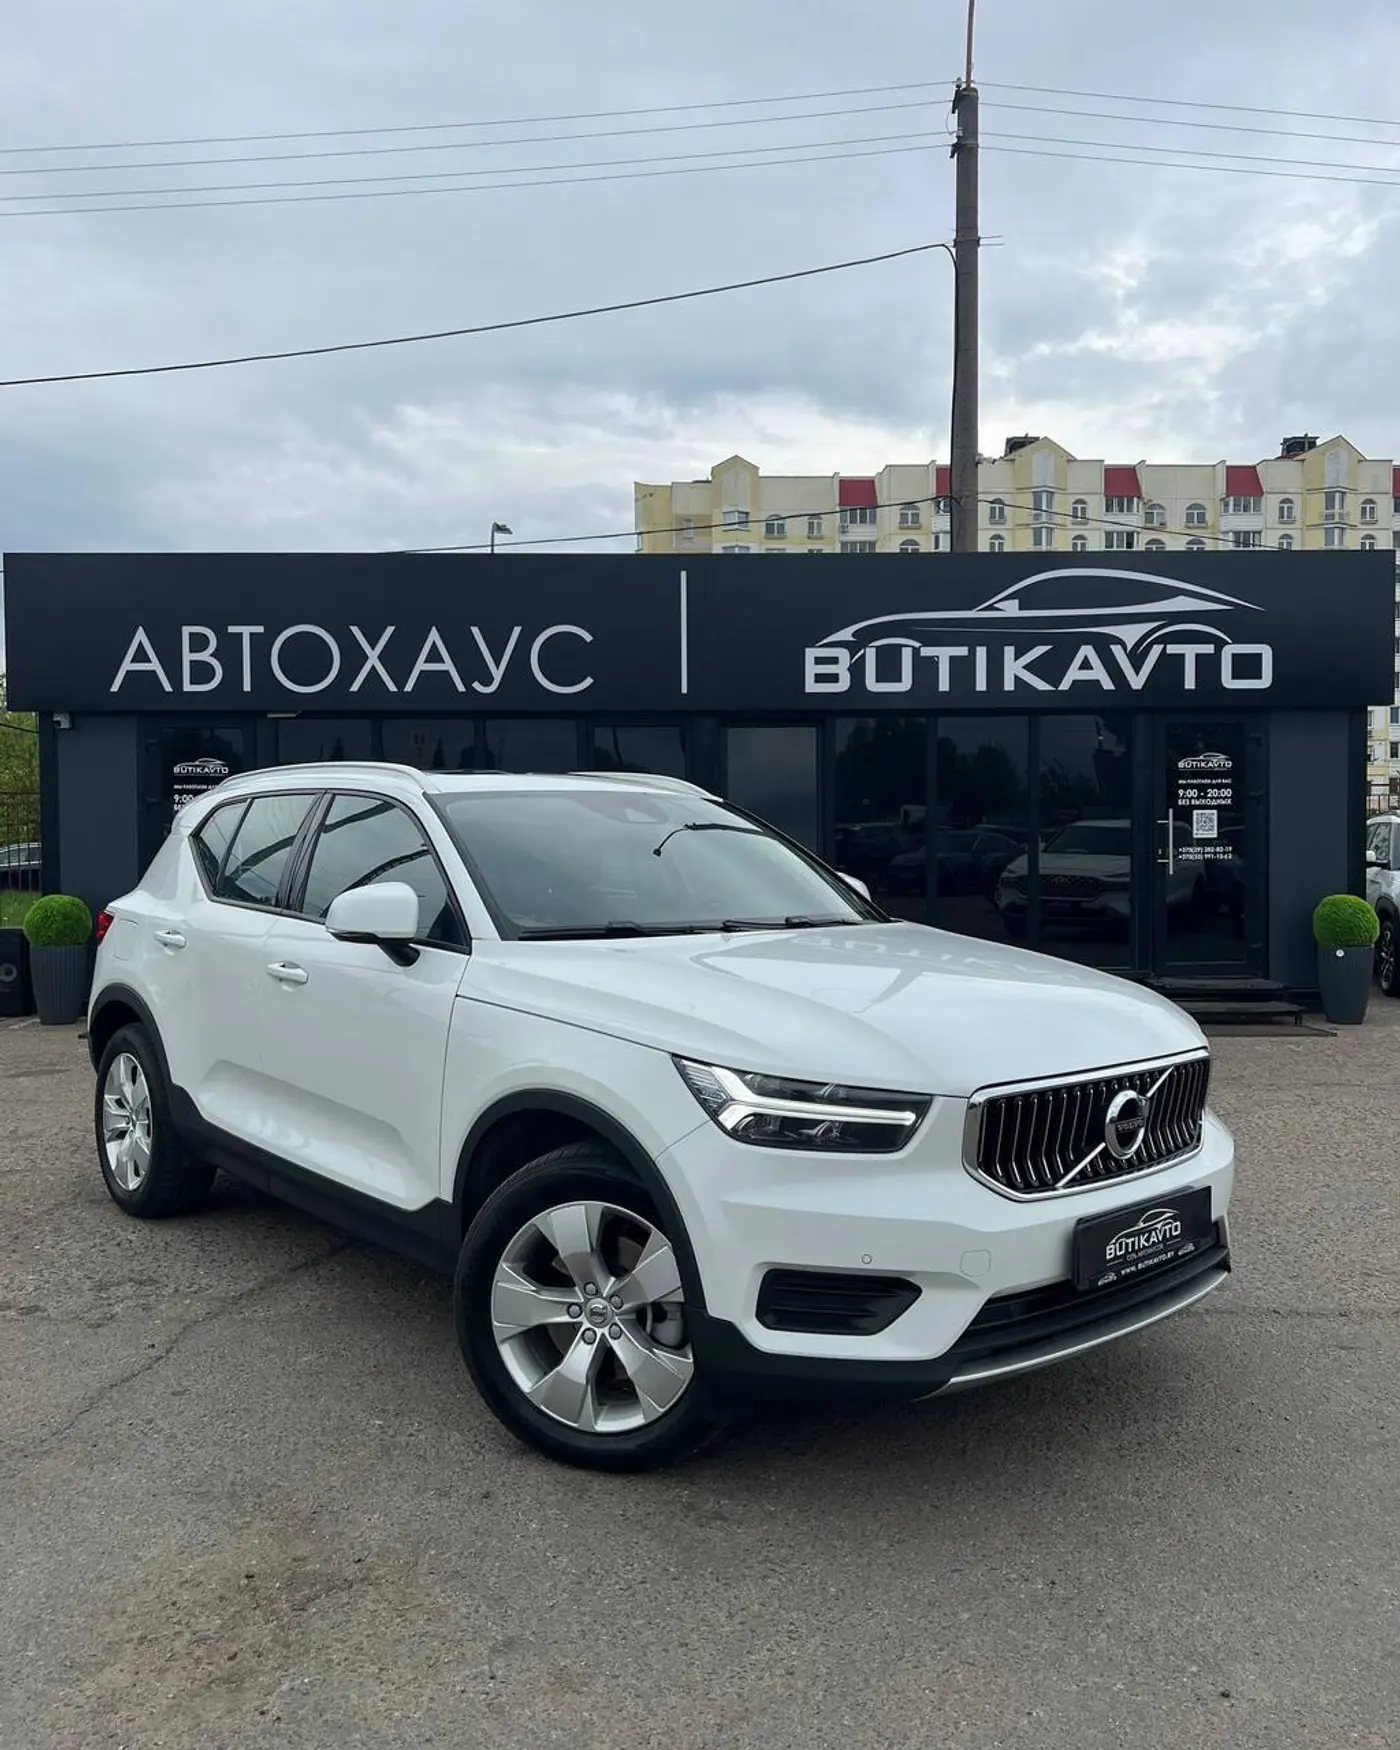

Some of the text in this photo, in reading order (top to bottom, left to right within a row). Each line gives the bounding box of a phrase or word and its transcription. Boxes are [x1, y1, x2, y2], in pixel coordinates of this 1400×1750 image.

[110, 624, 594, 694] АВТОХАУС
[804, 643, 1273, 693] BUTIKAVTO
[1178, 789, 1198, 798] 9:00
[1207, 789, 1232, 798] 20:00
[1106, 1221, 1181, 1260] BUTIKAVTO
